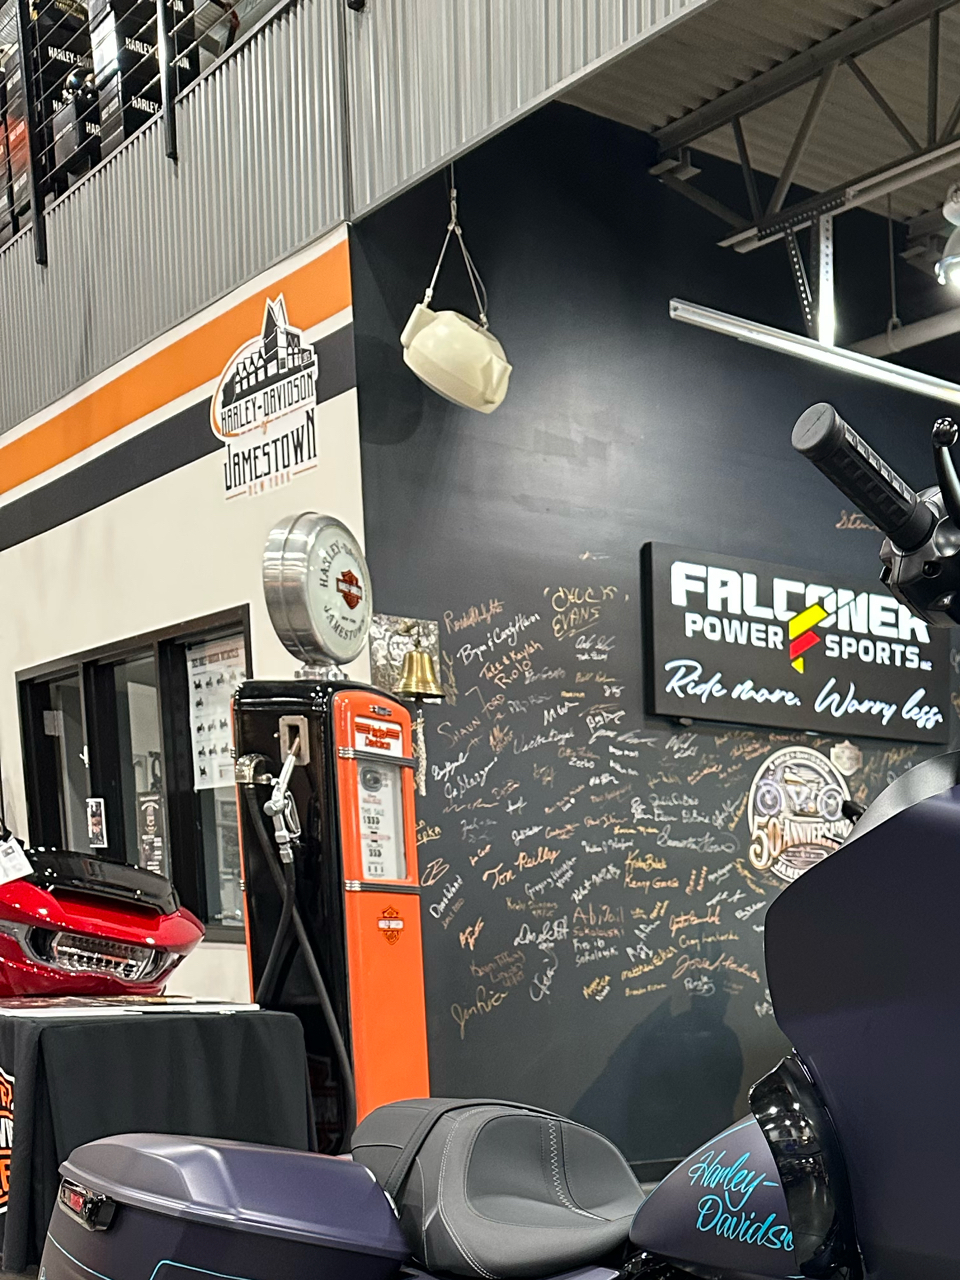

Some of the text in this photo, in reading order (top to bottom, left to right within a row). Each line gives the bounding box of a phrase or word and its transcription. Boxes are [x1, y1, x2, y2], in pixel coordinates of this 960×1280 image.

[221, 369, 315, 437] HARLEY-DAVIDSON
[223, 407, 318, 492] JAMESTOWN
[670, 561, 931, 644] FALCONER
[684, 612, 784, 650] POWER
[825, 634, 920, 669] SPORTS
[664, 658, 727, 705] Ride
[731, 679, 802, 708] more.
[814, 677, 897, 727] Worry
[749, 815, 782, 869] 50
[781, 818, 855, 851] ANNIVERSARY
[687, 1150, 780, 1211] Harley-
